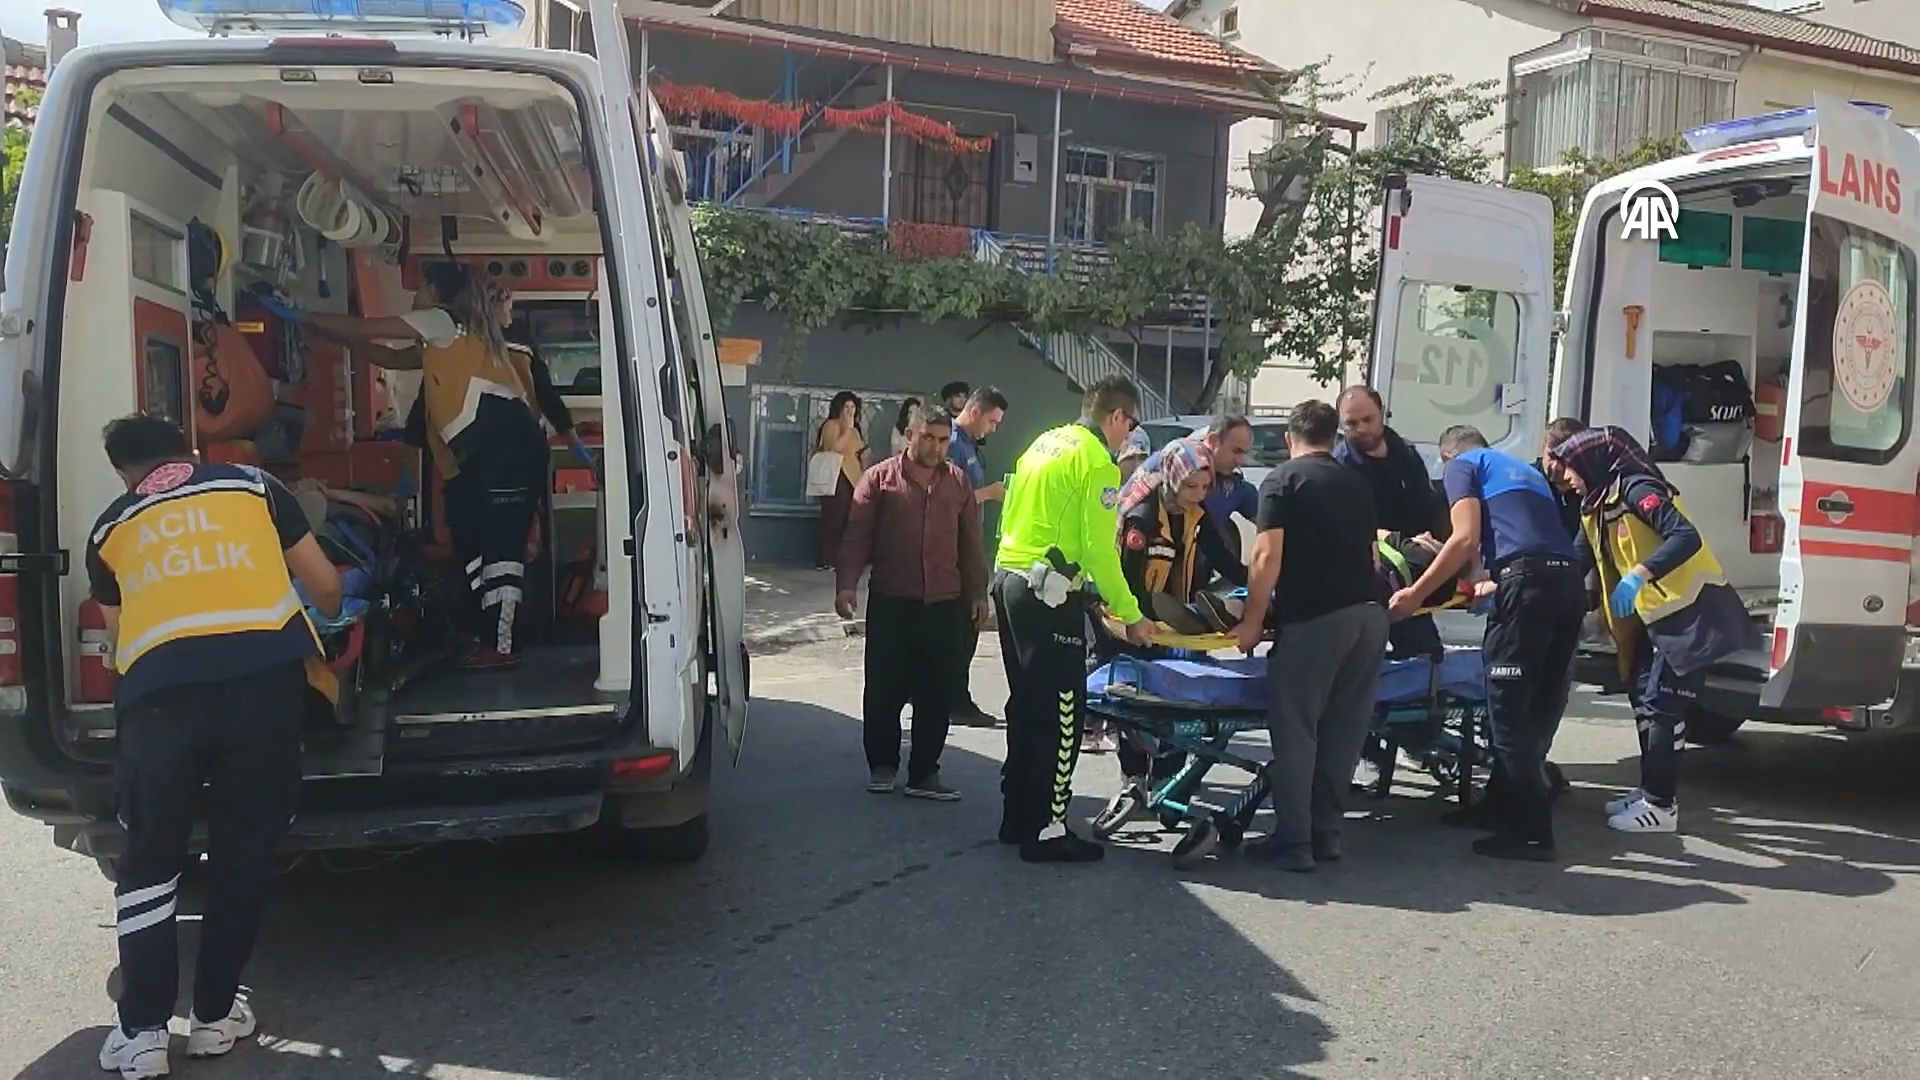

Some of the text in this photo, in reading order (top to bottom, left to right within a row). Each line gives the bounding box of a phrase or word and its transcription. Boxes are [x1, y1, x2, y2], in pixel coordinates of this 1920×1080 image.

[1820, 145, 1900, 214] LANS
[137, 507, 222, 553] ACİL
[125, 542, 255, 594] SAĞLIK
